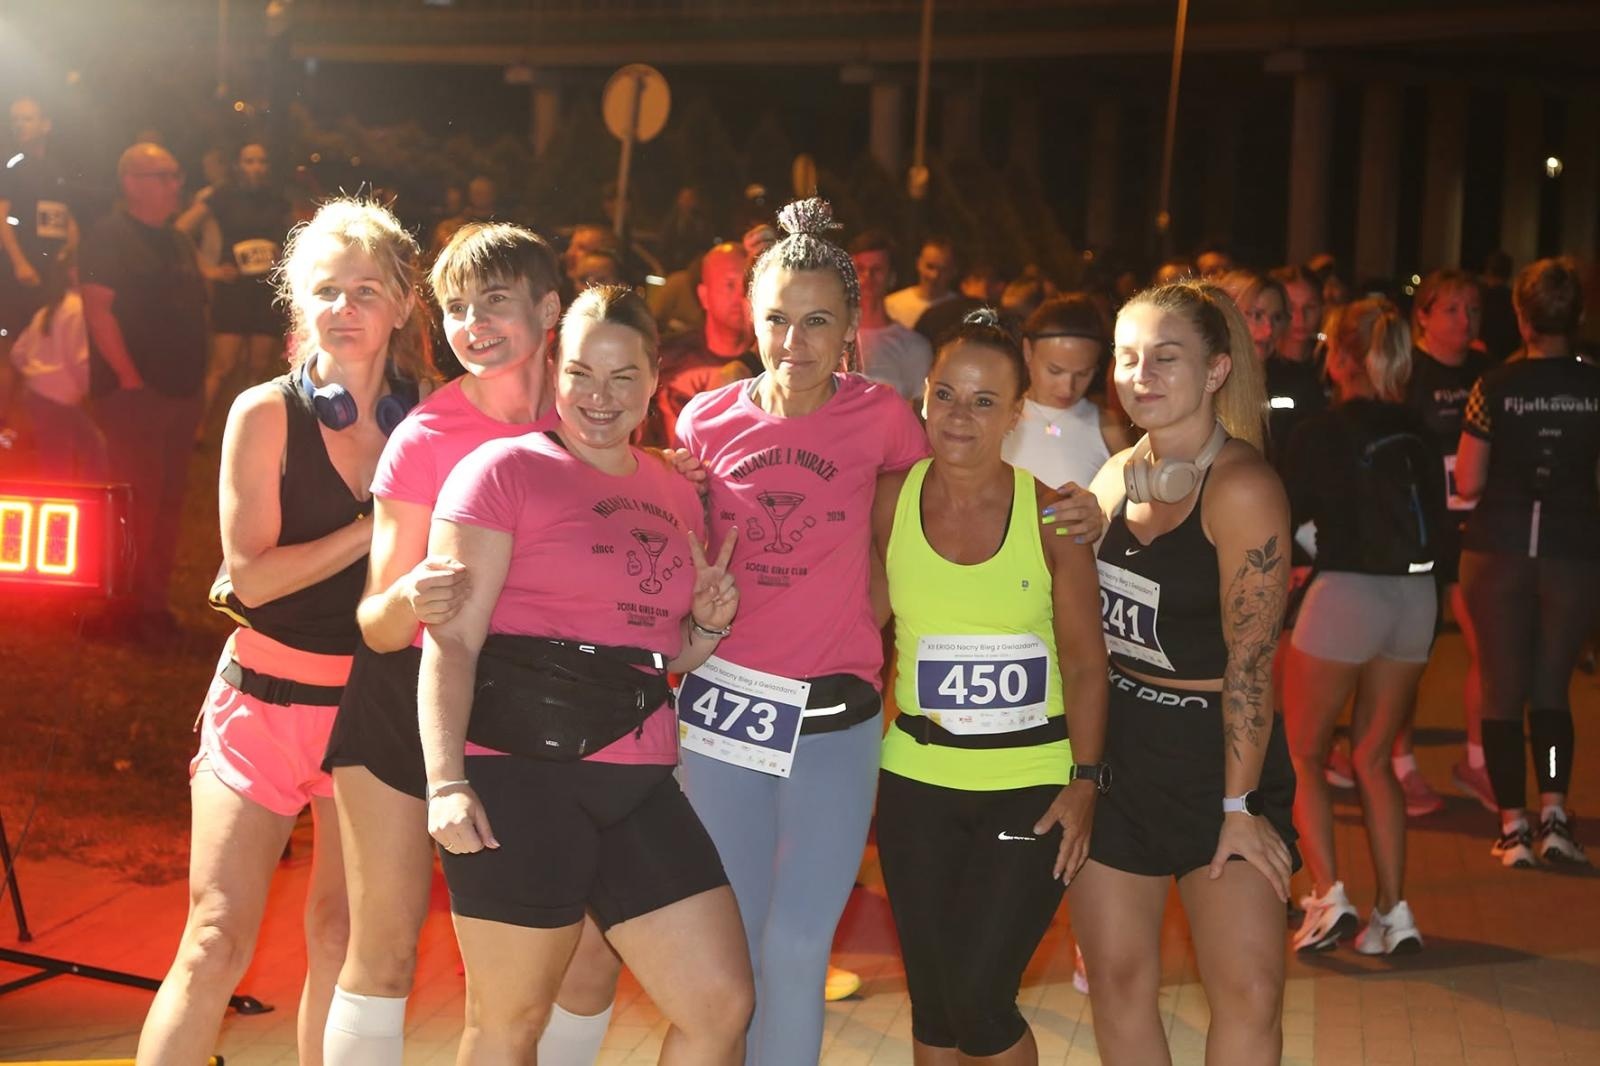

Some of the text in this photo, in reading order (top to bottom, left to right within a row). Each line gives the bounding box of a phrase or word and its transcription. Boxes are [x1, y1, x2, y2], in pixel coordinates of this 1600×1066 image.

[592, 543, 615, 554] since
[937, 663, 1029, 705] 450
[692, 687, 778, 742] 473
